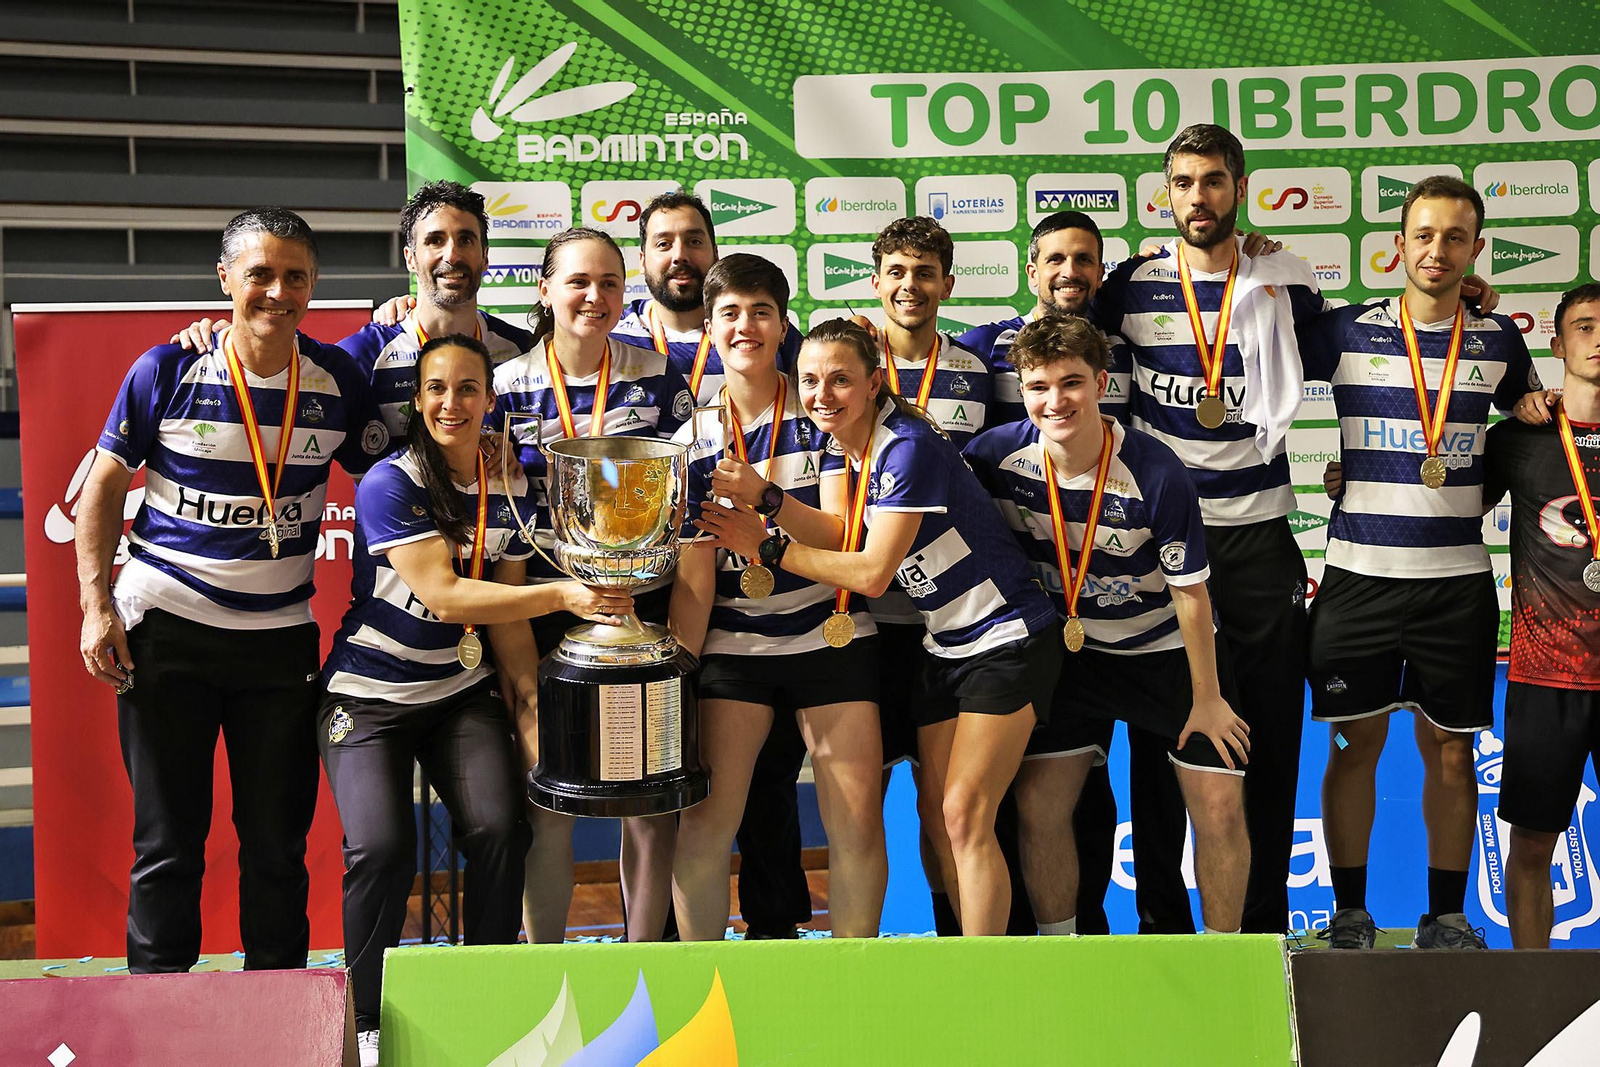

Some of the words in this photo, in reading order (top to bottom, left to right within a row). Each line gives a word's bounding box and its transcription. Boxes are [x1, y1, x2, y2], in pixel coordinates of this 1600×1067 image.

[665, 109, 748, 126] ESPAÑA
[870, 82, 1050, 148] TOP
[1083, 78, 1181, 144] 10
[517, 132, 749, 163] BADMINTON
[1510, 183, 1569, 196] Iberdrola
[841, 199, 897, 211] Iberdrola
[952, 196, 1004, 208] LOTERÍAS
[1068, 193, 1114, 208] YONEX
[492, 219, 562, 229] BADMINTON
[511, 268, 541, 284] YON
[953, 263, 1009, 276] Iberdrola
[1150, 373, 1246, 407] Huelv
[1363, 419, 1476, 453] Hueva
[1289, 451, 1340, 463] Iberdrol
[1482, 813, 1495, 847] MARIS
[1567, 825, 1584, 879] CUSTODIA
[1487, 850, 1502, 894] PORTUS
